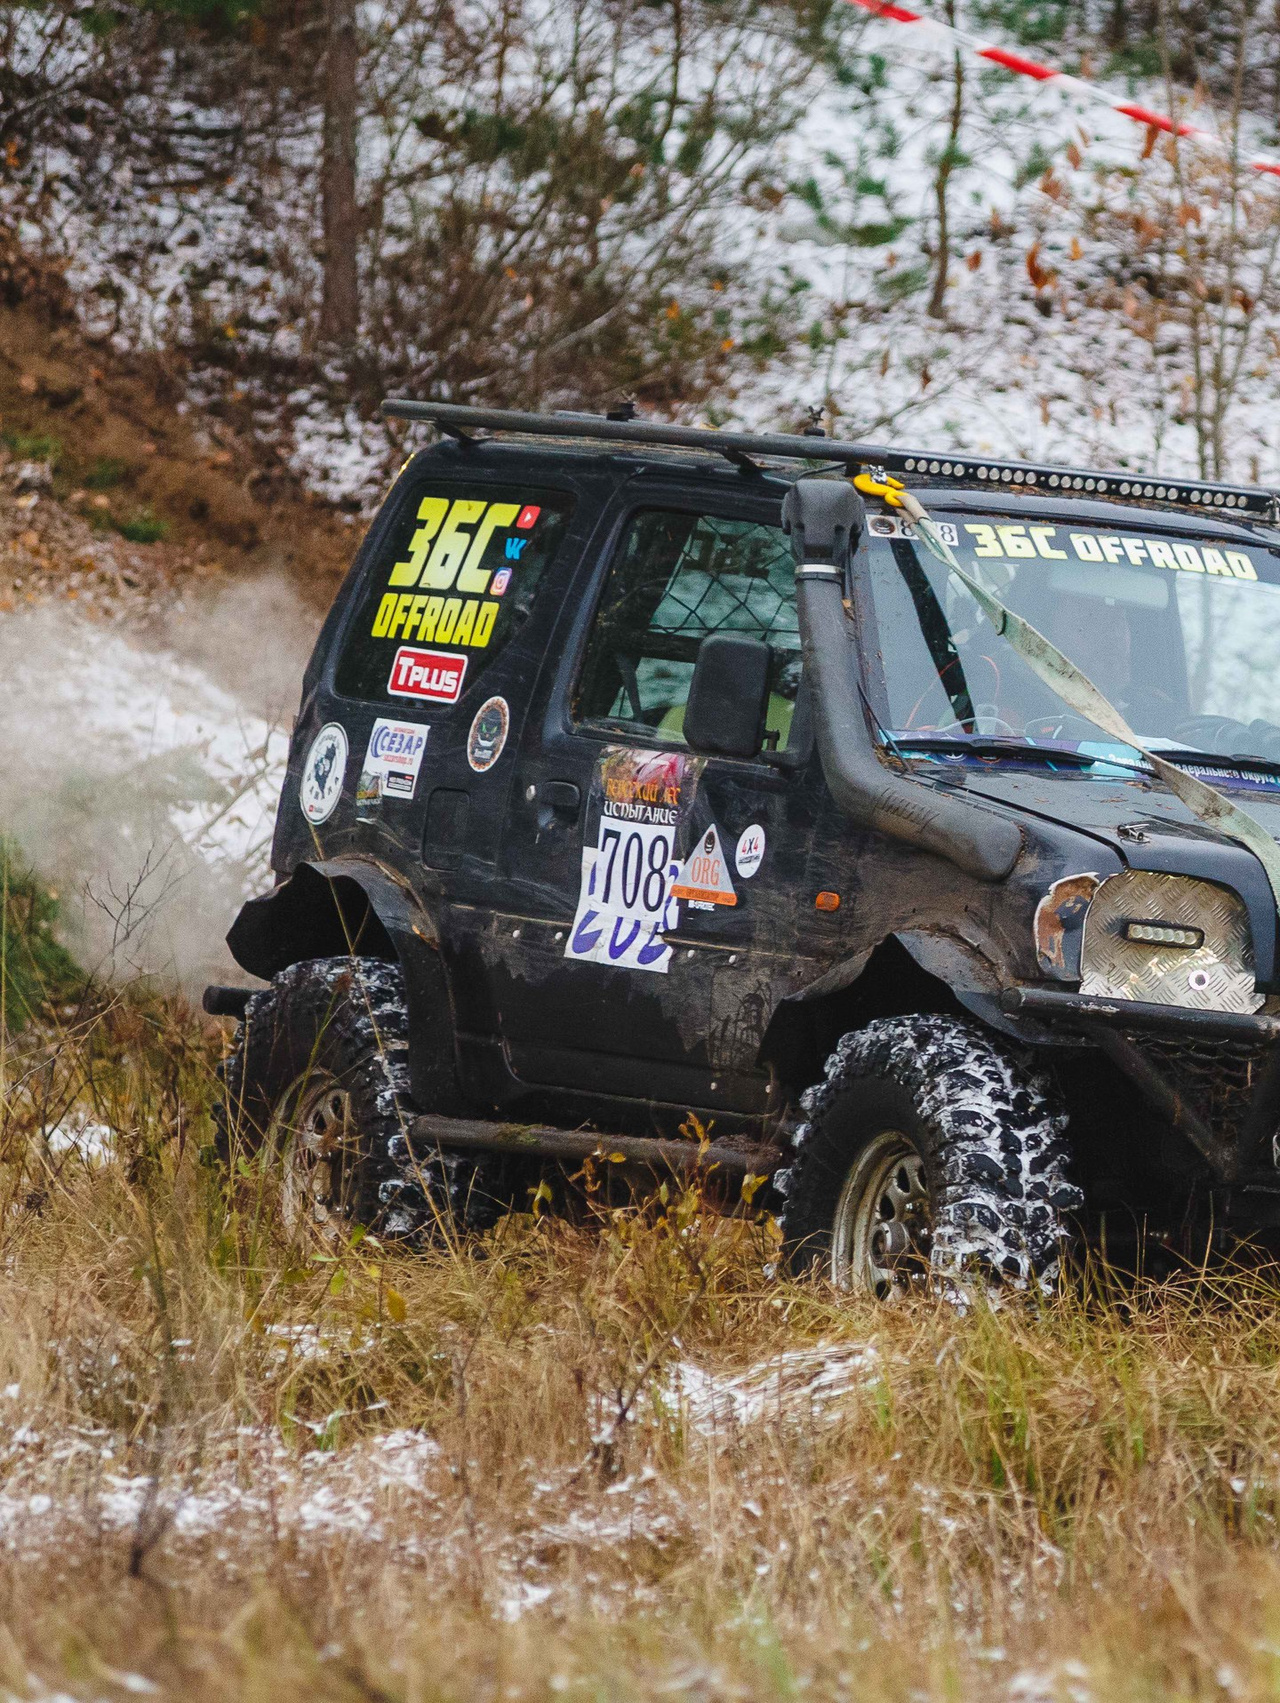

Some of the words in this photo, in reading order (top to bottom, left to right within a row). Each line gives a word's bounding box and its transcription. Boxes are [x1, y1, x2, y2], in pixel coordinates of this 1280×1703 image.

[1069, 533, 1258, 581] OFFROAD
[371, 592, 500, 648] OFFROAD
[380, 731, 424, 756] СЕЗАР
[600, 827, 670, 912] 708
[691, 857, 721, 886] ORG
